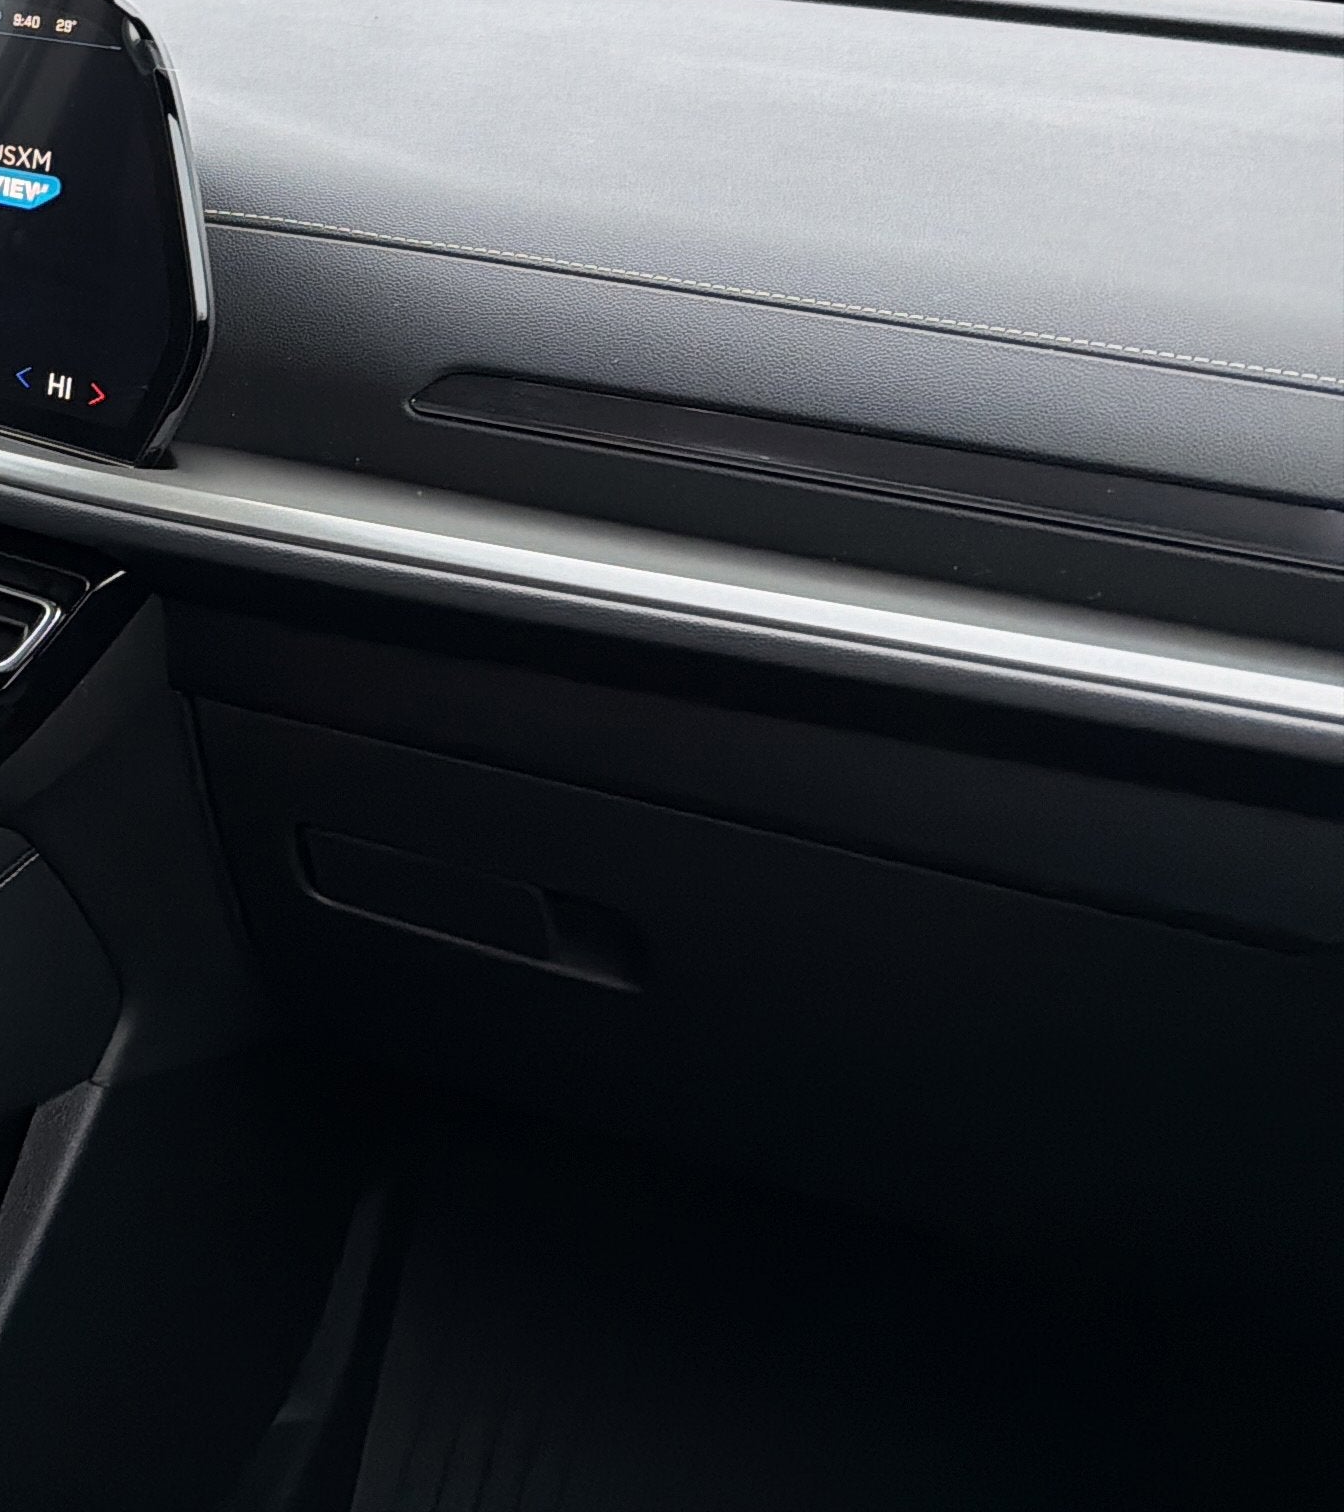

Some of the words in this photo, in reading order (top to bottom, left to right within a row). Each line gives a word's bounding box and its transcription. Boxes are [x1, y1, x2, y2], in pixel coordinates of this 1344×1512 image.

[12, 13, 41, 29] 9:40
[55, 18, 77, 33] 29°
[46, 371, 73, 401] HI
